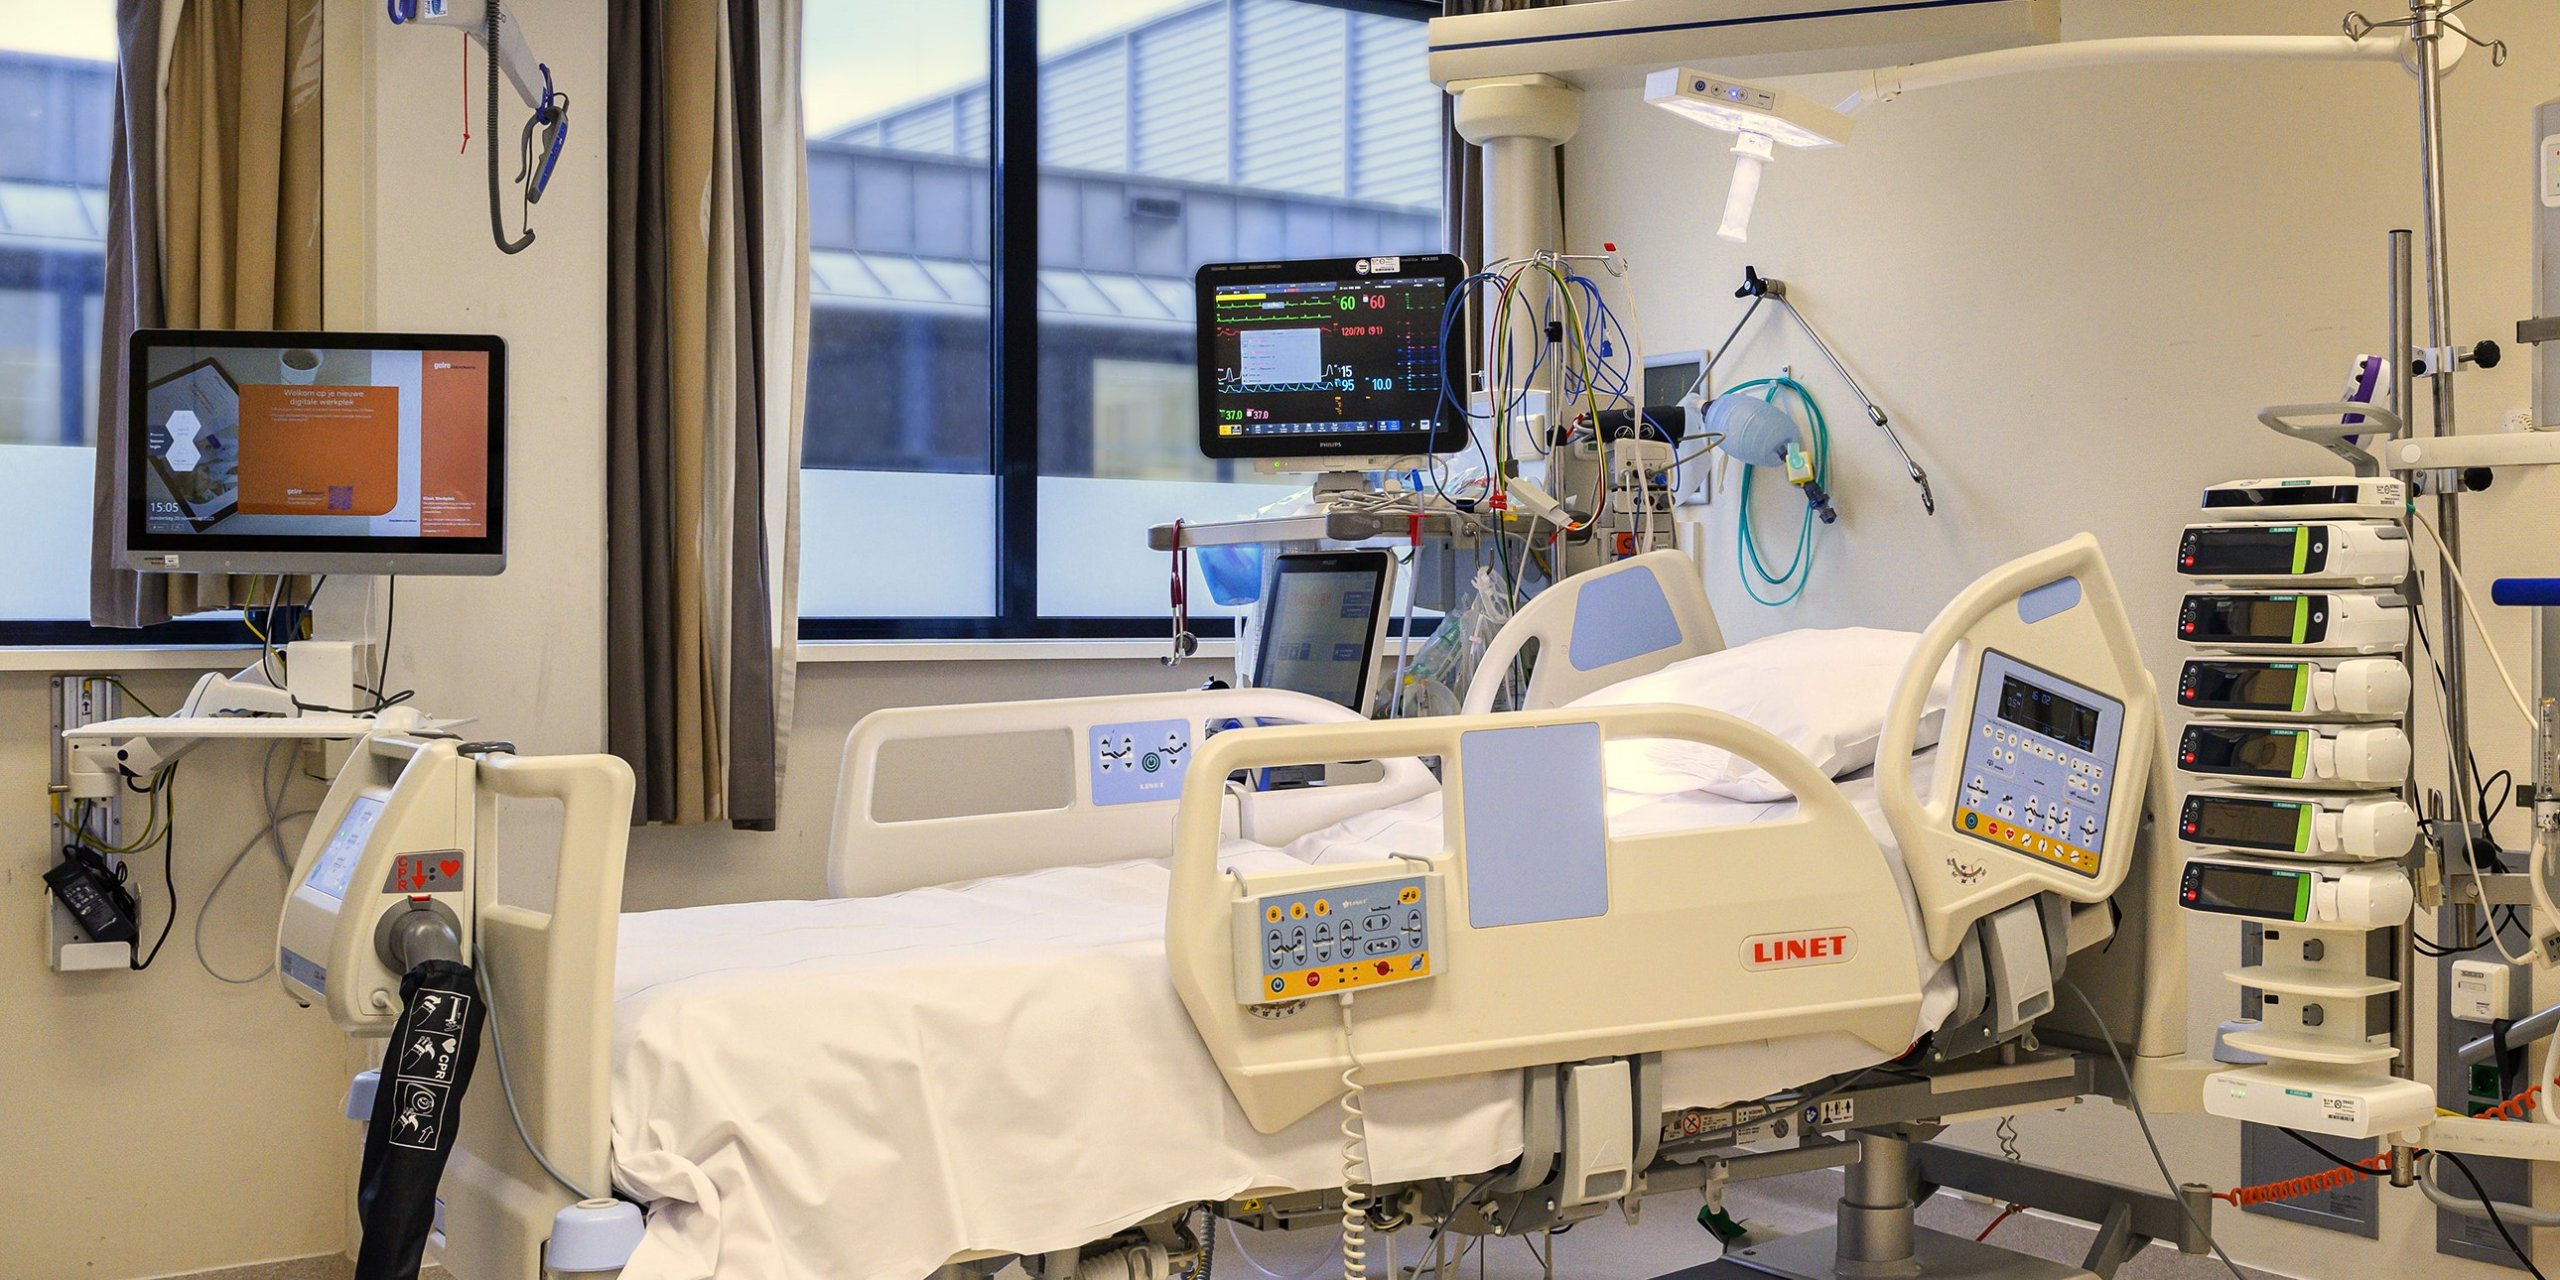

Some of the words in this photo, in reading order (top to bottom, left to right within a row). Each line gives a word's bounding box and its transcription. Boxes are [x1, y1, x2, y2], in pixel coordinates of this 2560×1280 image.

[1340, 296, 1356, 310] 60
[1370, 294, 1386, 309] 60
[1341, 326, 1365, 336] 120/70
[1368, 325, 1383, 336] (91)
[1341, 365, 1353, 378] 15
[1341, 379, 1355, 392] 95
[1372, 377, 1392, 391] 10.0
[283, 389, 315, 397] Welkom
[316, 391, 327, 399] op
[289, 398, 318, 407] digitale
[319, 399, 354, 407] werkplek
[1225, 410, 1243, 420] 37.0
[1253, 410, 1269, 420] 37.0
[150, 502, 179, 513] 15:05
[1754, 935, 1847, 963] LINET
[435, 1054, 450, 1080] CPR
